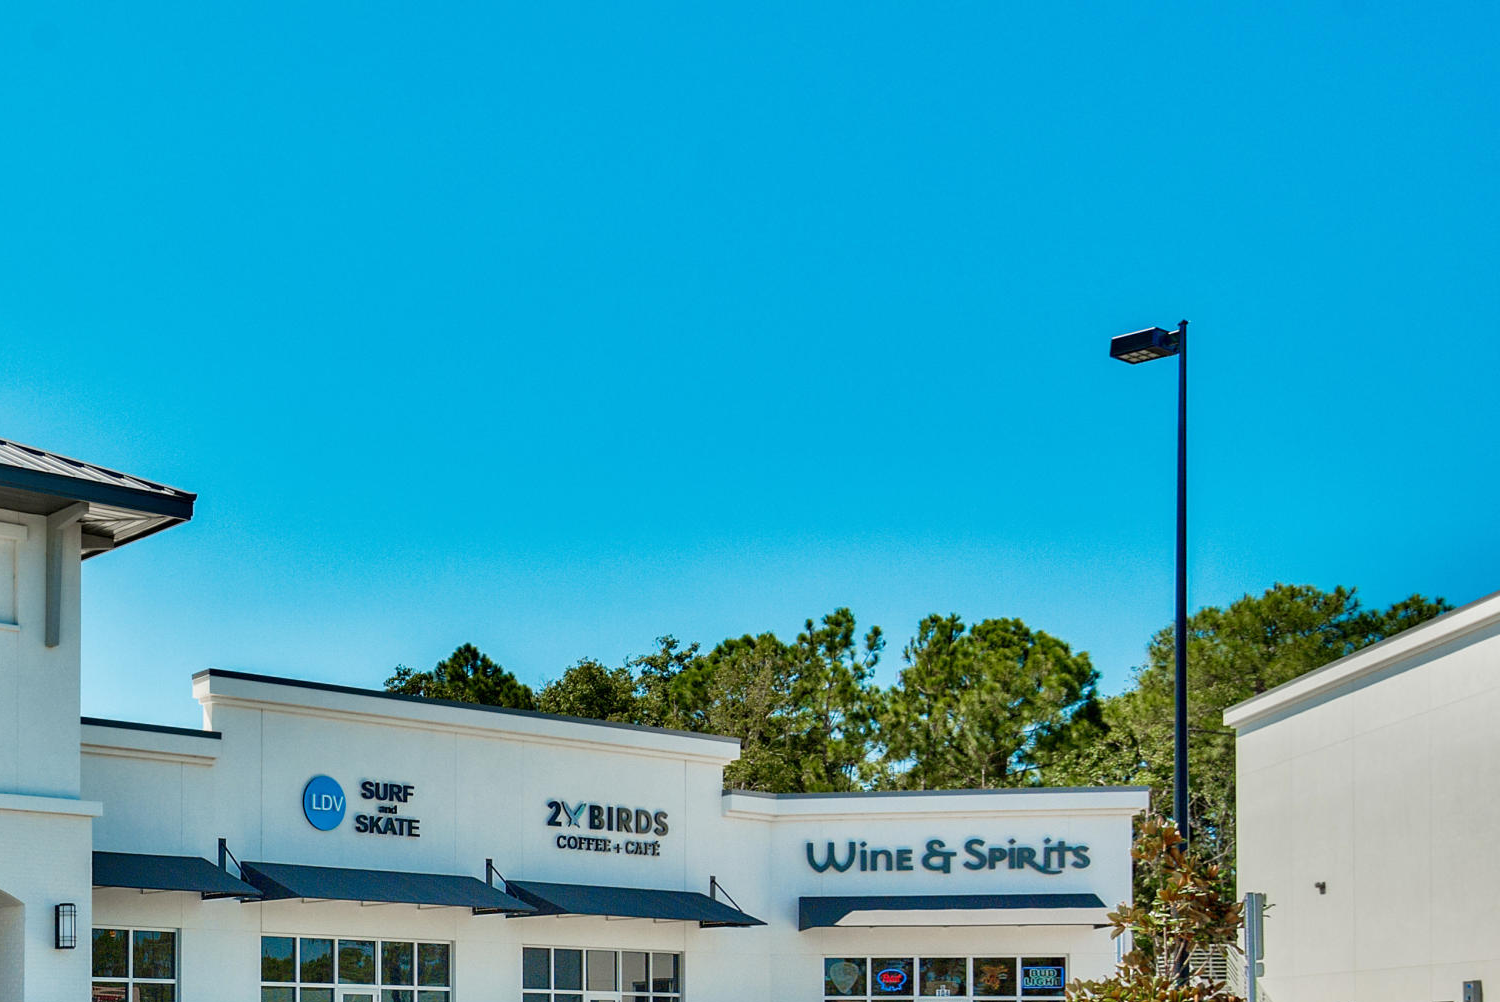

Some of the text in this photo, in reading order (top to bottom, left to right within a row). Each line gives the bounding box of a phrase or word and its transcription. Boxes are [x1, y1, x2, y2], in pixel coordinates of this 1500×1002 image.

[312, 793, 344, 812] LDV
[361, 781, 415, 803] SURF
[378, 805, 398, 815] and
[589, 804, 669, 837] BIRDS
[355, 814, 421, 838] SKATE
[556, 835, 612, 853] COFFEE
[625, 840, 661, 857] CAFÉ
[921, 839, 957, 874] &
[1023, 976, 1062, 987] LIGHT
[1029, 968, 1057, 978] BUD
